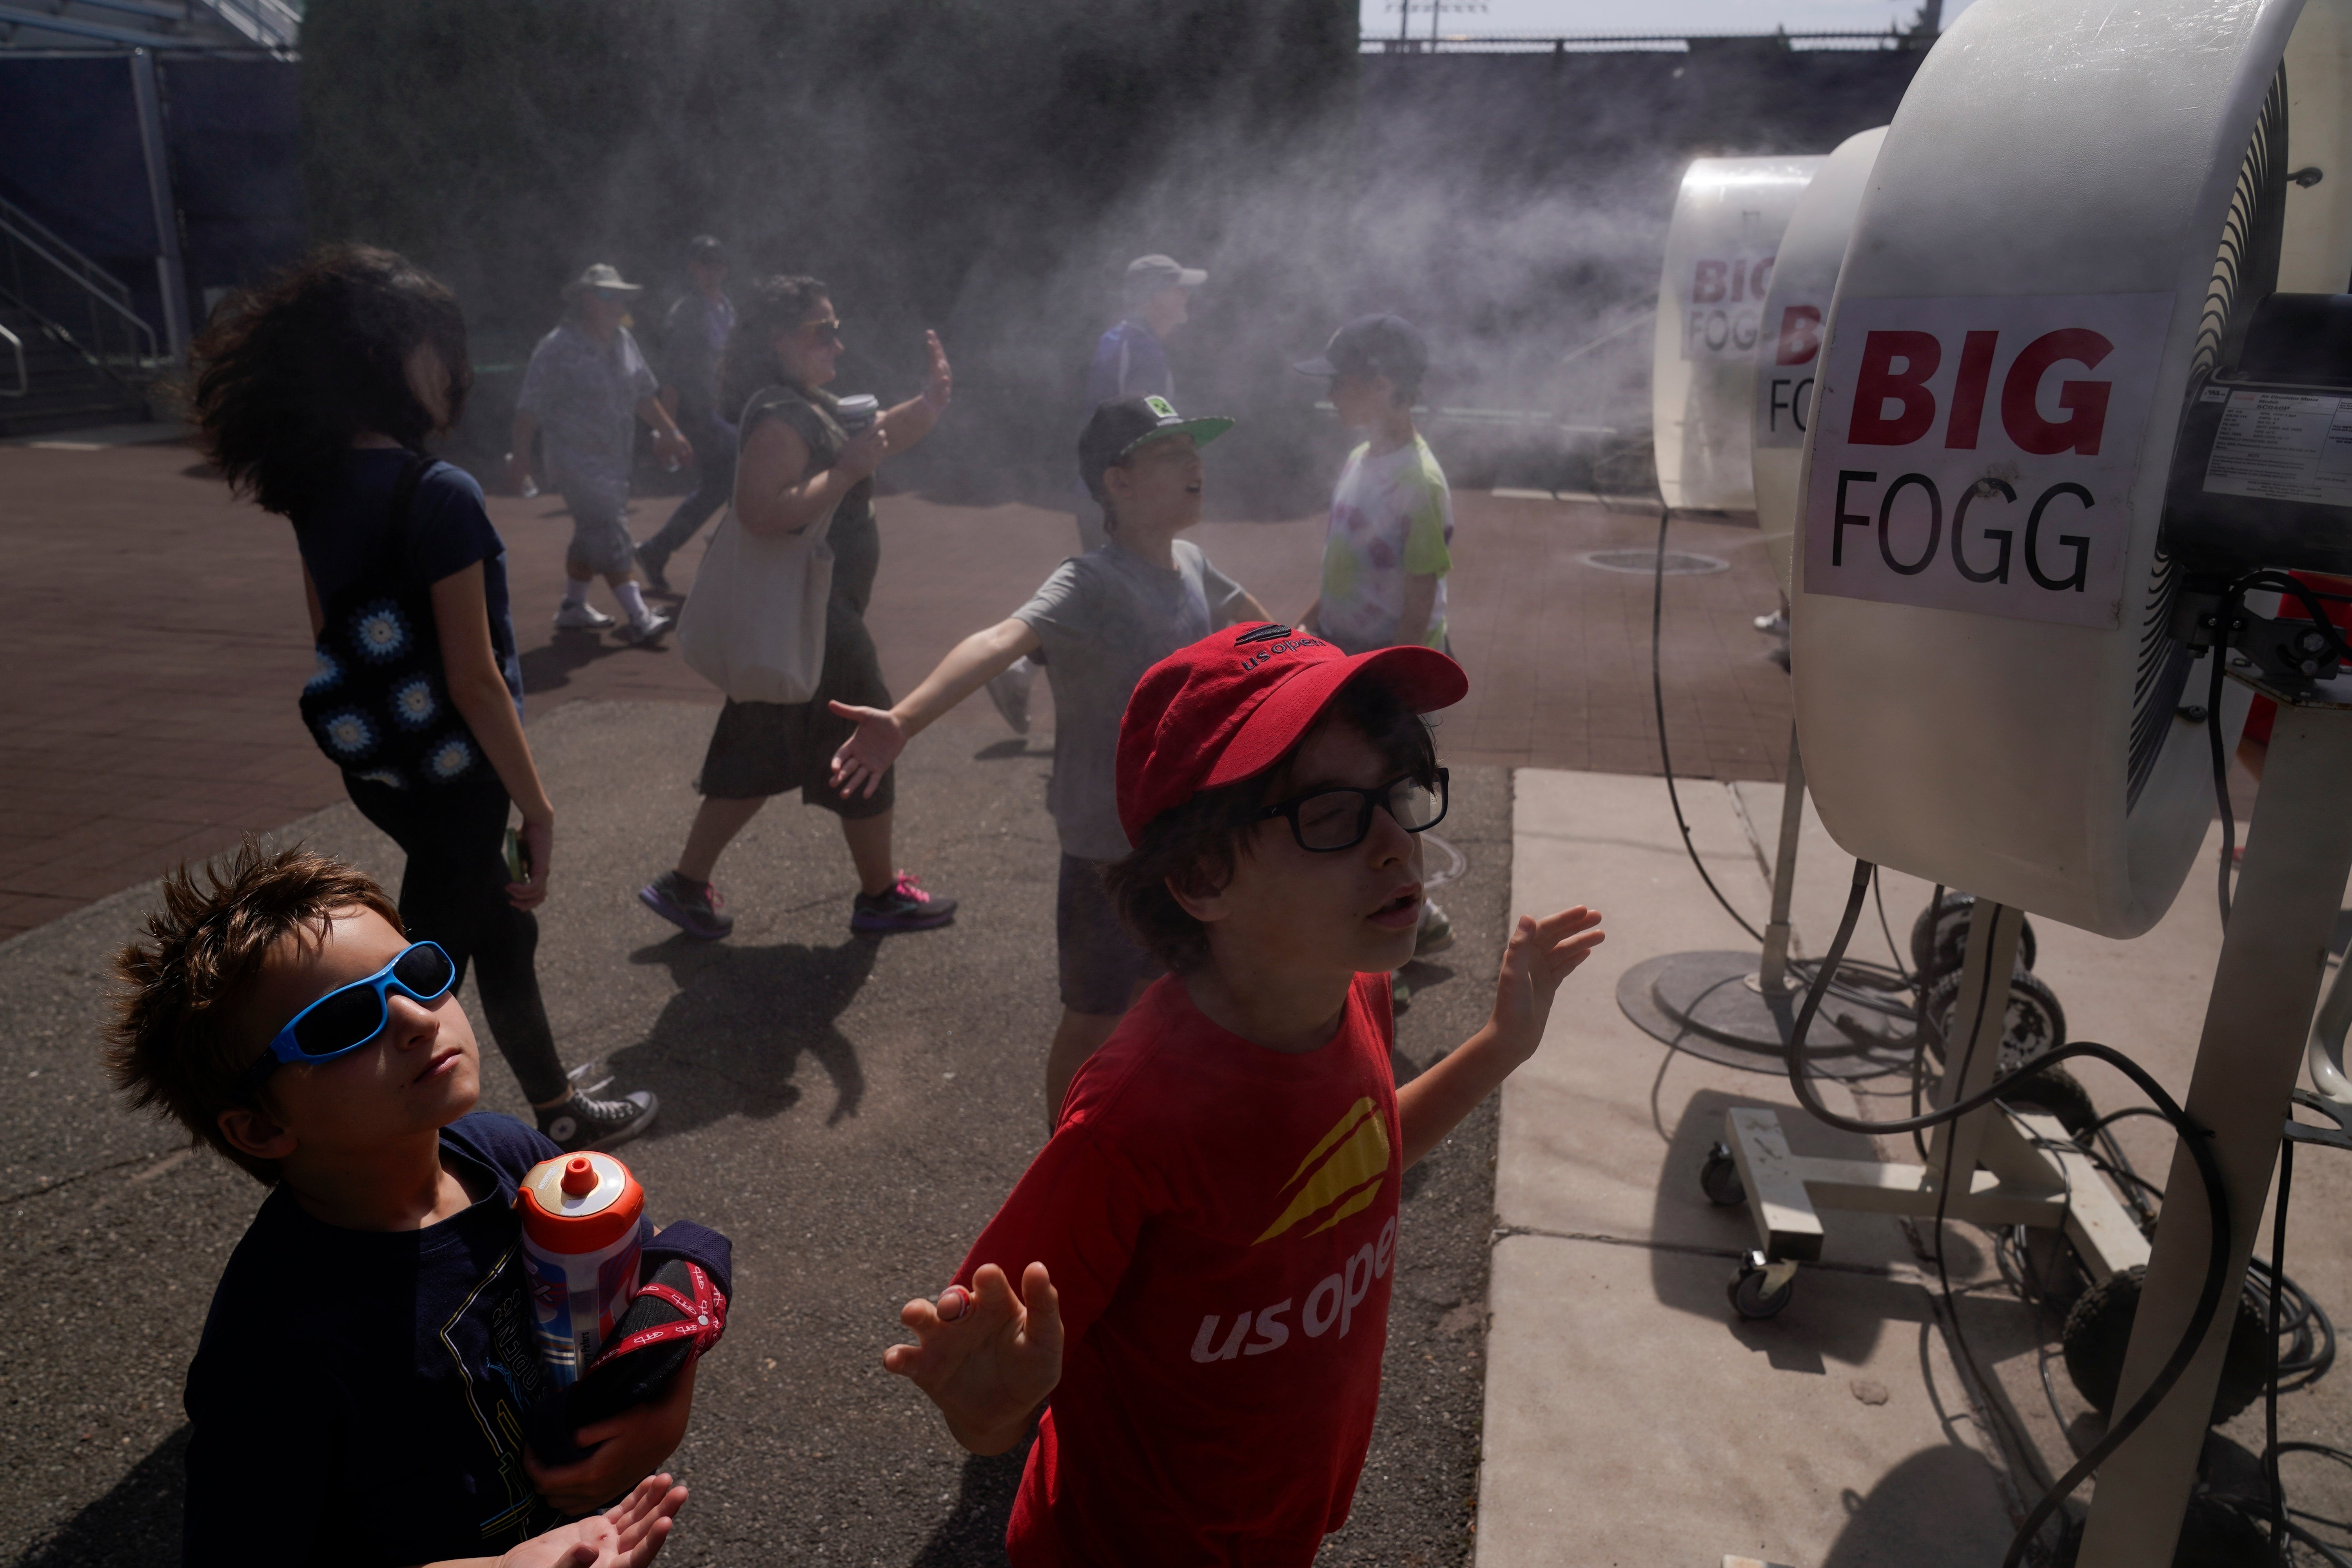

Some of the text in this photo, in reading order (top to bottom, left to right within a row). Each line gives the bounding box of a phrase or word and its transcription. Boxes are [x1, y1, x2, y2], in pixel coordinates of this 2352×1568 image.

[1690, 310, 1759, 351] FOG
[1847, 328, 2115, 455] BIG
[1832, 470, 2095, 592] FOGG
[1242, 637, 1325, 671] us open
[1190, 1215, 1397, 1363] us ope
[580, 1331, 590, 1352] Peters
